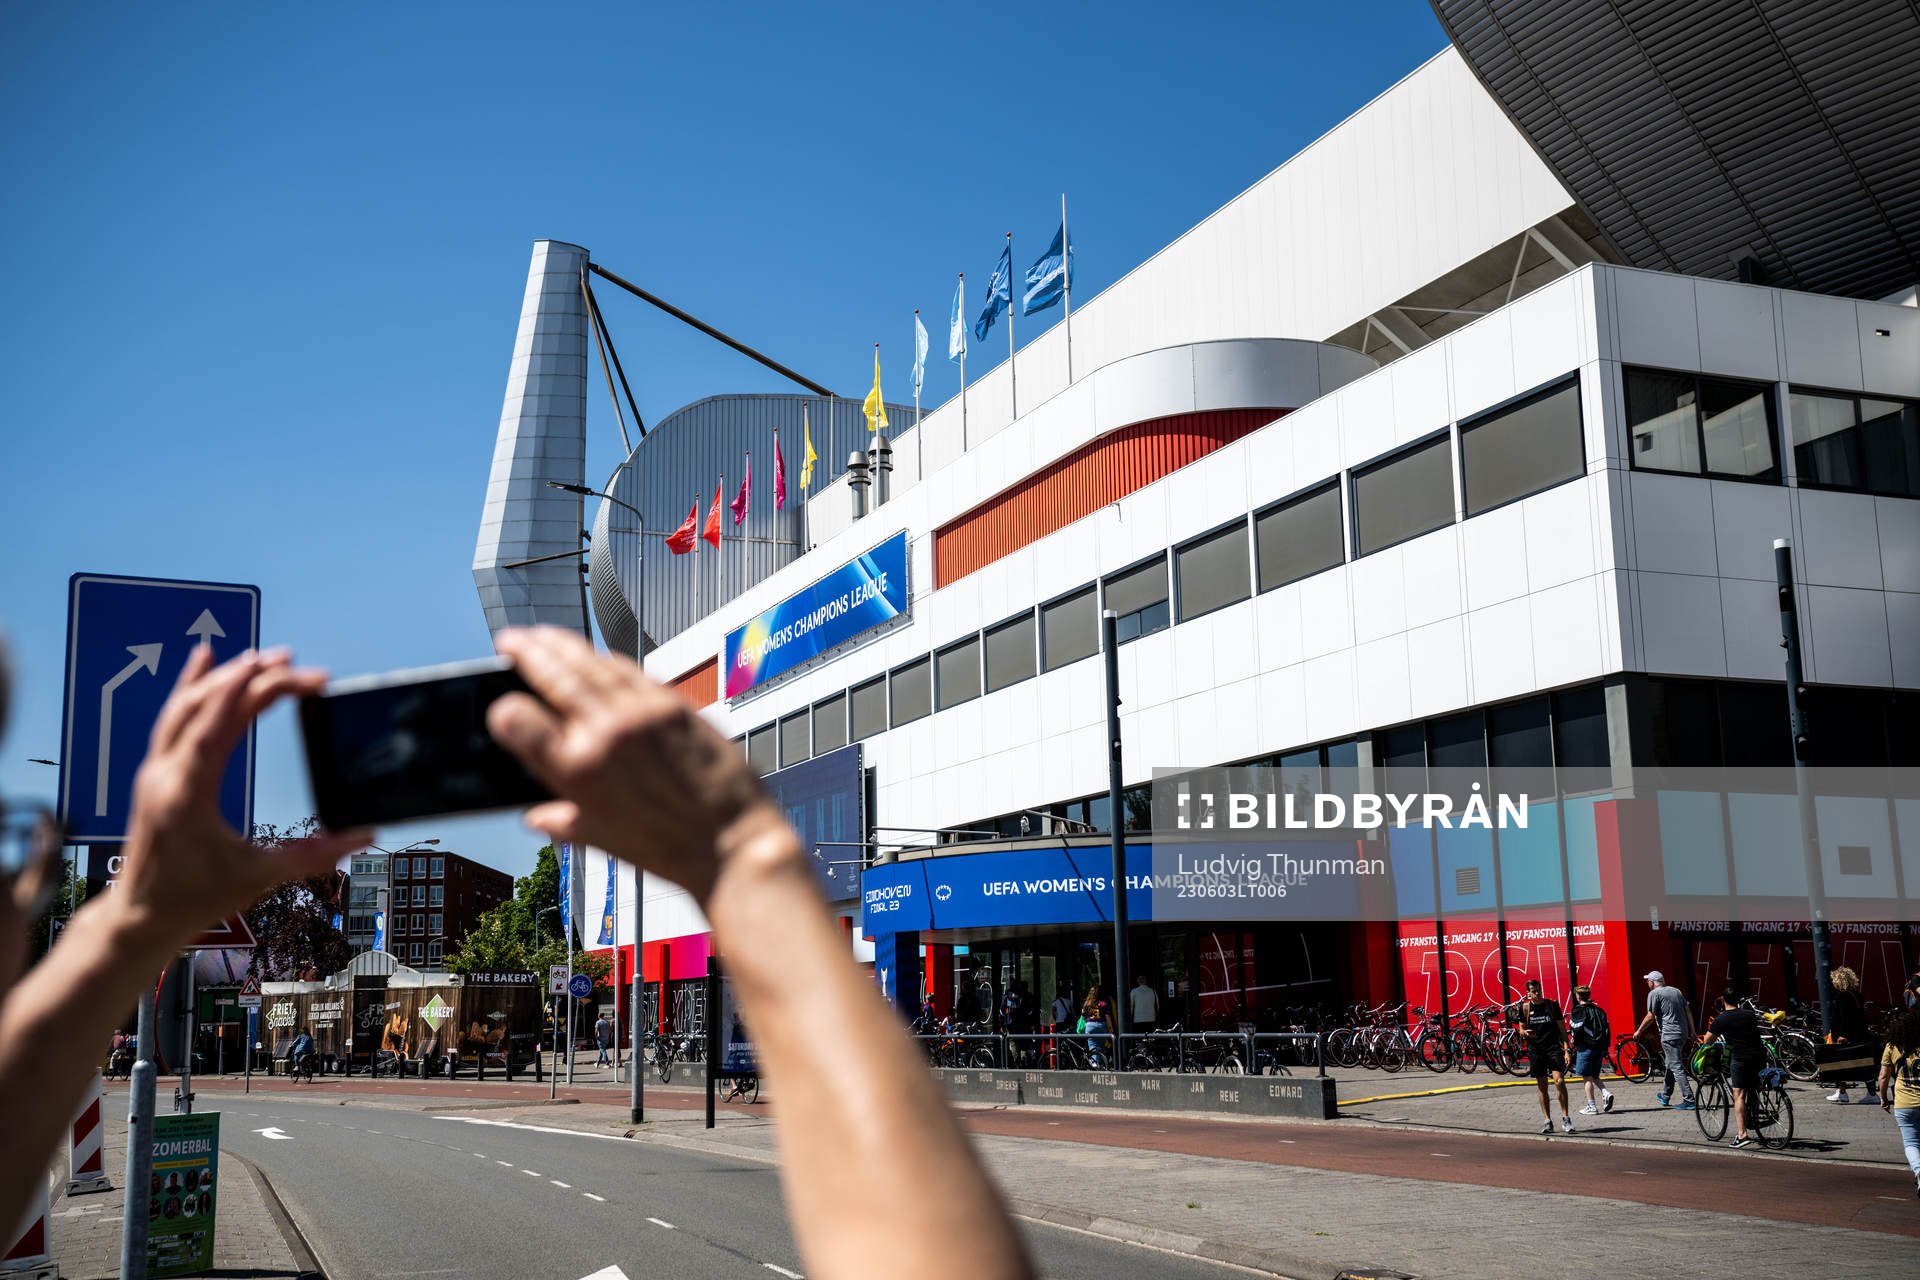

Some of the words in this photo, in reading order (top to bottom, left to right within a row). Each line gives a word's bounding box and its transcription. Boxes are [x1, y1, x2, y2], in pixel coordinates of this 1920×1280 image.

[738, 647, 756, 668] UEFA
[756, 625, 792, 657] WOMEN'S
[794, 594, 848, 637] CHAMPIONS
[851, 572, 887, 609] LEAGUE
[983, 882, 1020, 896] UEFA
[1025, 877, 1106, 893] WOMEN'S
[1111, 873, 1230, 890] HAMPIONS
[865, 885, 911, 903] EINDHOVEN
[870, 902, 888, 914] FINAL
[889, 900, 900, 911] 23
[1742, 921, 1785, 932] INGANG
[1787, 922, 1800, 932] 17
[1410, 935, 1450, 947] FANSTOE,
[1451, 932, 1483, 944] INGANG
[1483, 932, 1494, 942] 17
[1506, 930, 1522, 940] PSV
[470, 973, 491, 983] THE
[494, 972, 535, 983] BAKERY
[272, 1002, 294, 1017] FRIET
[418, 1007, 429, 1018] THE
[430, 1007, 455, 1018] BAKERY
[1025, 1072, 1044, 1084] ERNIE
[1092, 1074, 1118, 1086] MATEJA
[1141, 1079, 1161, 1091] MARK
[1190, 1081, 1205, 1093] JAN
[1269, 1084, 1303, 1099] EDWARD
[1037, 1086, 1064, 1098] RONALDO
[1074, 1091, 1099, 1104] LIEUWE
[1219, 1090, 1240, 1103] RENE
[151, 1139, 213, 1157] ZOMERBAL
